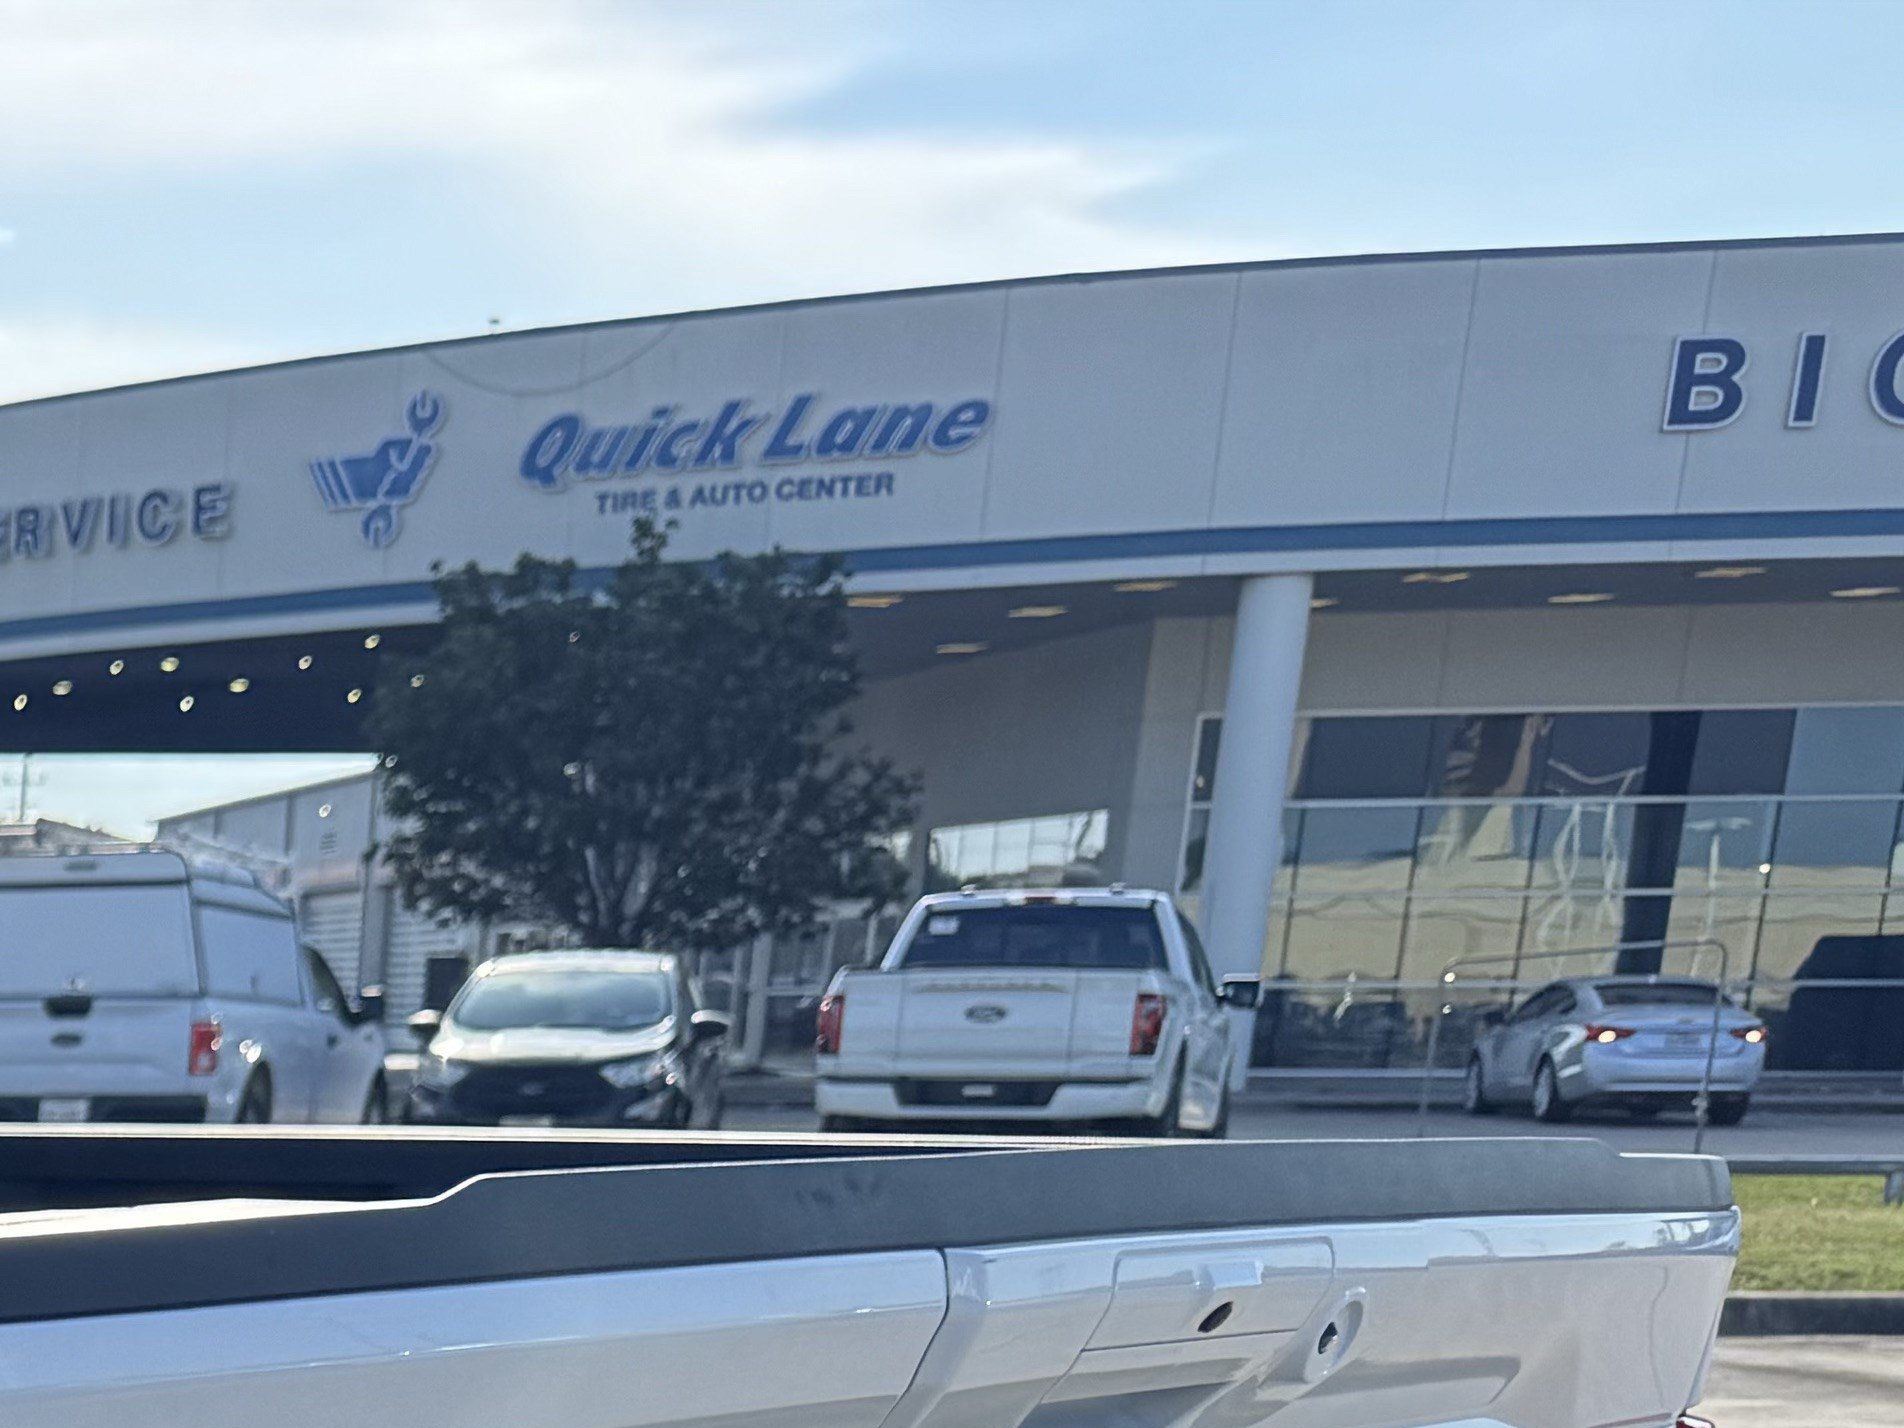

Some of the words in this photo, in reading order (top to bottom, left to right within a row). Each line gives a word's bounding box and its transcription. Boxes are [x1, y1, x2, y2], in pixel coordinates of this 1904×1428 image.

[519, 400, 760, 488] Quick
[760, 394, 990, 466] Lane
[595, 489, 656, 514] TIRE
[665, 487, 681, 509] &
[689, 480, 767, 508] AUTO
[775, 472, 895, 502] CENTER
